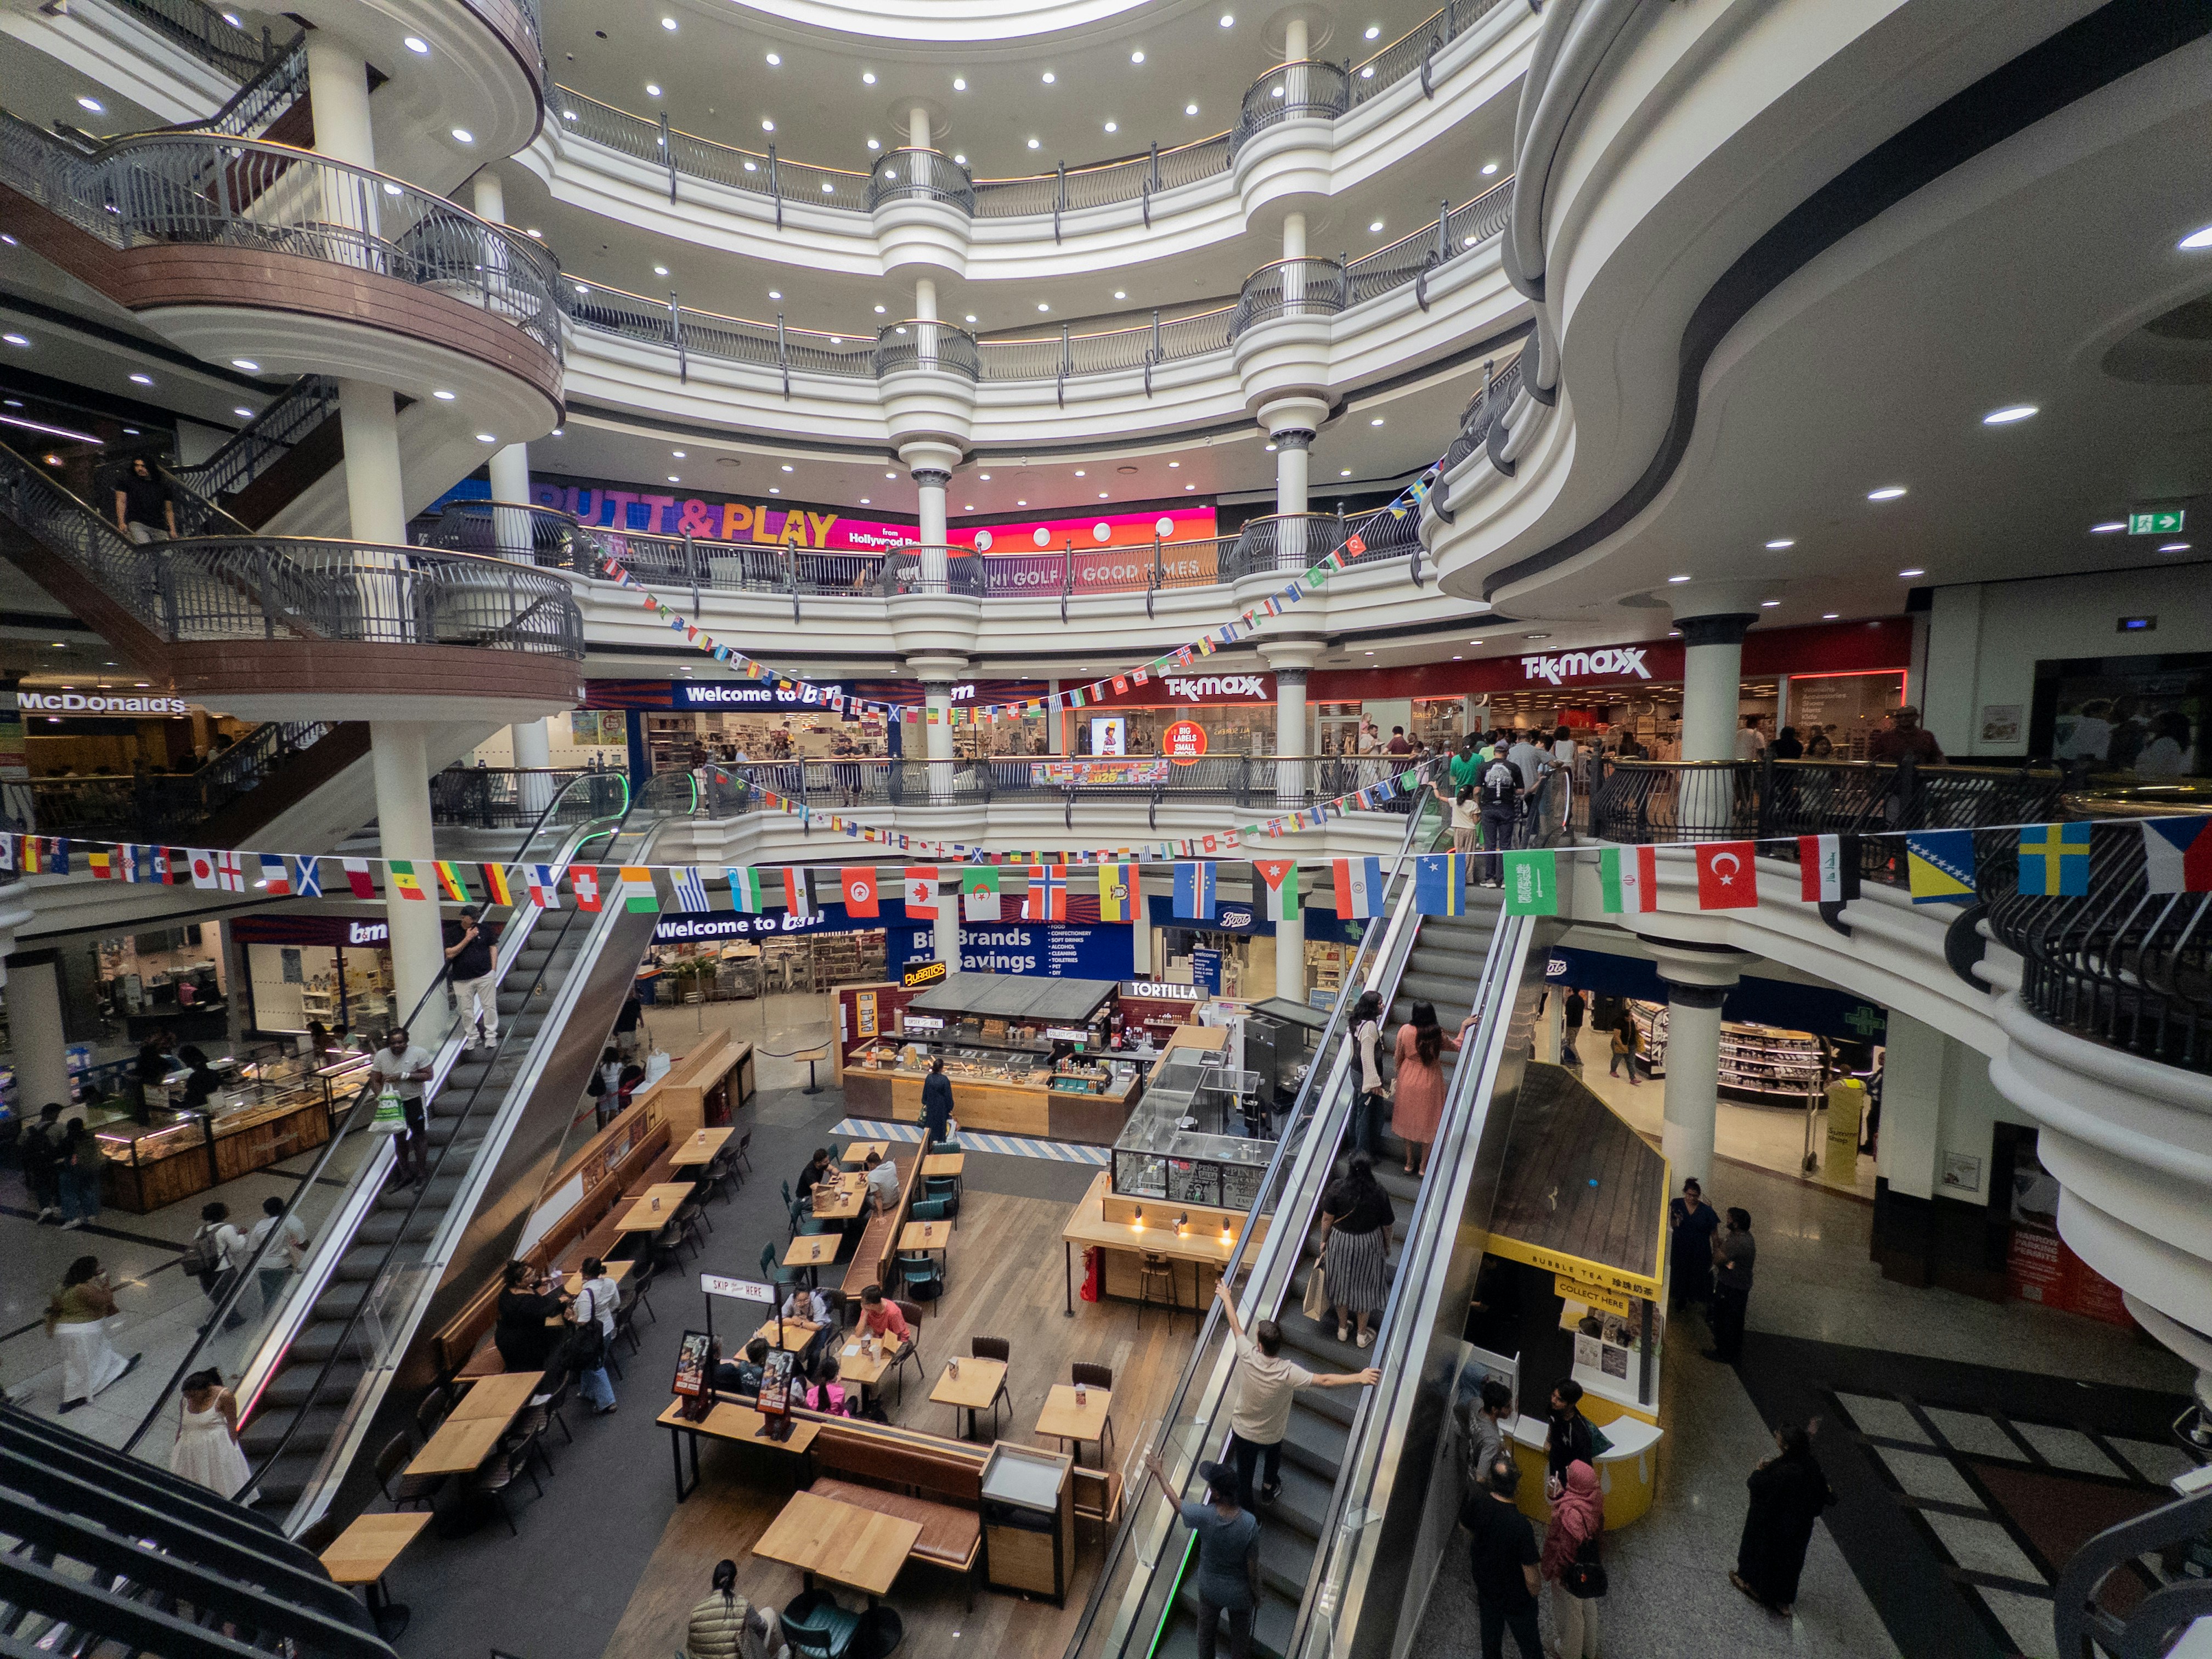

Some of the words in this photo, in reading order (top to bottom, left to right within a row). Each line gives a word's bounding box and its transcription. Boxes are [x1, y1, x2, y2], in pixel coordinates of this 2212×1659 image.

[678, 499, 714, 538] &
[721, 503, 838, 548] PLAY
[1014, 570, 1058, 586] GOLF
[1083, 565, 1138, 582] GOOD
[1144, 560, 1199, 575] TMES
[16, 692, 186, 713] McDonald's
[686, 686, 771, 702] Welcome
[776, 689, 796, 702] to
[1087, 772, 1117, 783] 2026
[657, 920, 748, 938] Welcome
[753, 917, 776, 931] to
[1220, 912, 1251, 927] Boots
[913, 930, 934, 949] Bi
[959, 928, 1031, 946] Brands
[960, 951, 1036, 973] avings
[905, 963, 945, 986] BURRITOS
[1132, 982, 1198, 1000] TORTILLA
[1533, 1256, 1574, 1273] BUBBLE
[1582, 1269, 1602, 1281] TEA
[713, 1280, 729, 1290] SKIP
[746, 1285, 761, 1297] HERE
[1559, 1284, 1599, 1301] COLLECT
[1601, 1296, 1623, 1309] HERE
[1612, 1277, 1654, 1297] 珍珠奶茶
